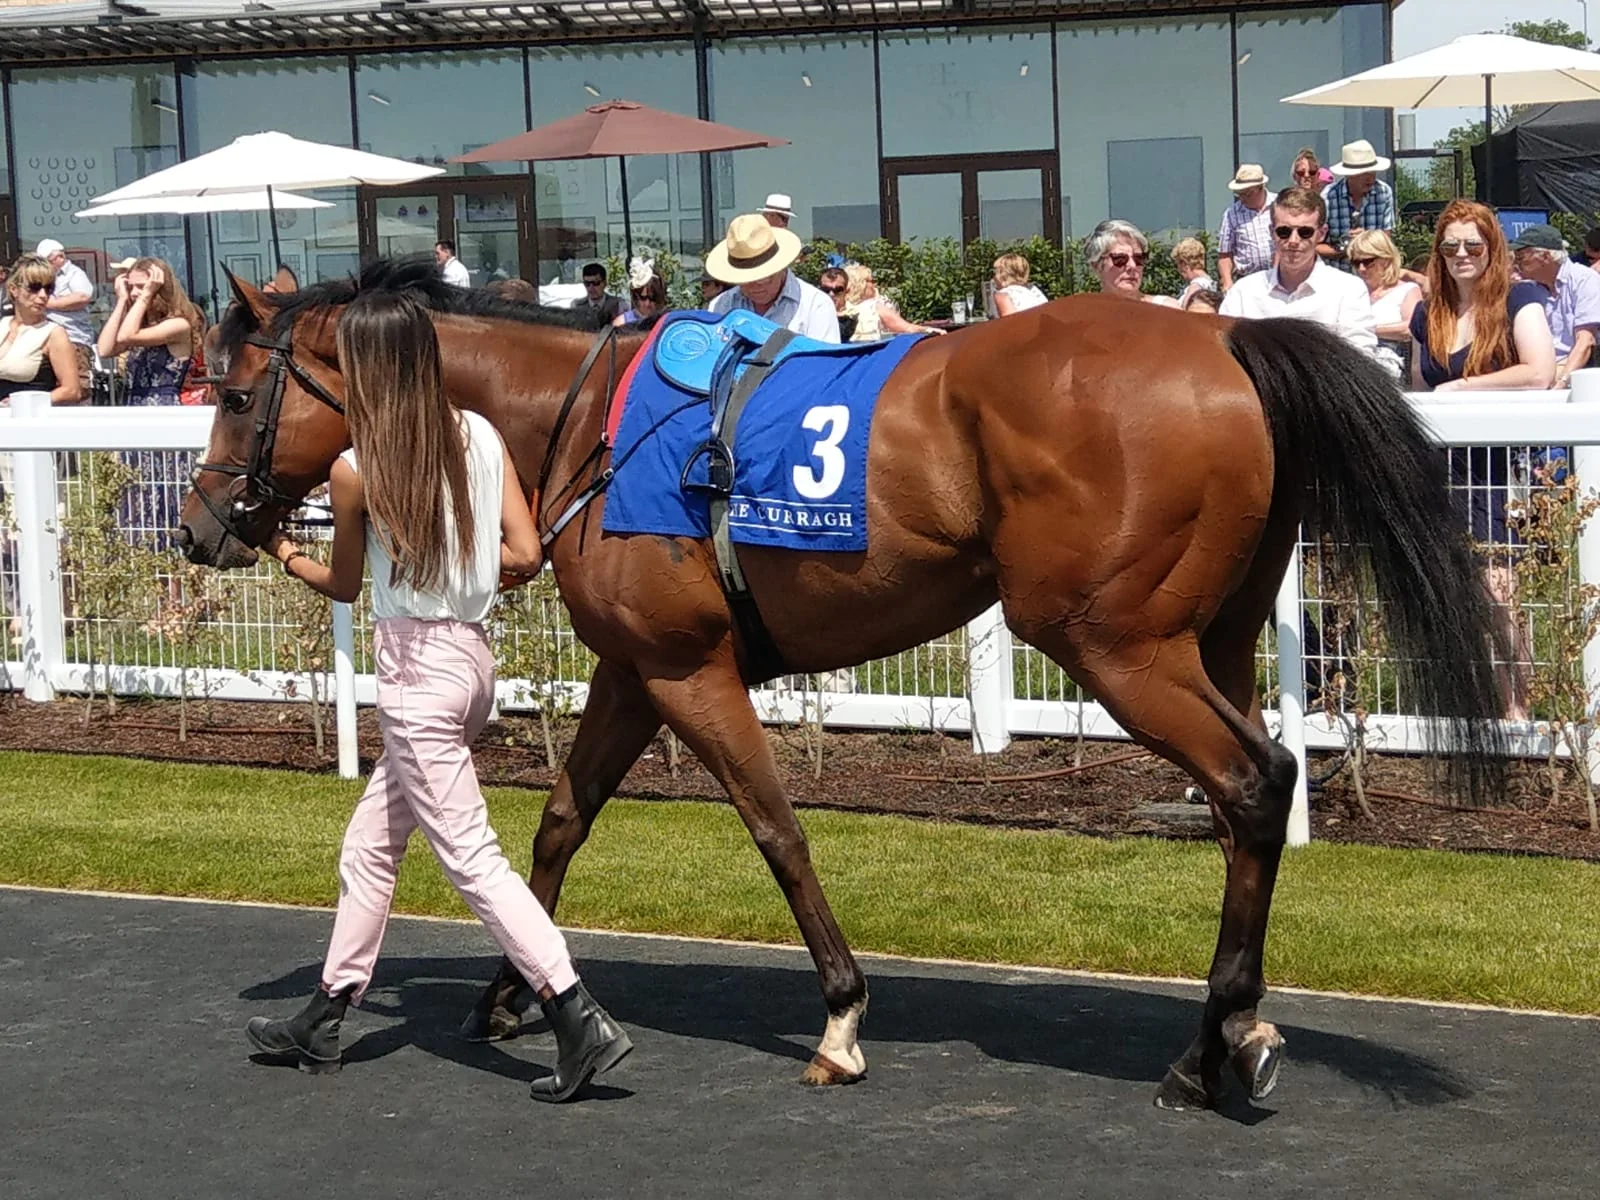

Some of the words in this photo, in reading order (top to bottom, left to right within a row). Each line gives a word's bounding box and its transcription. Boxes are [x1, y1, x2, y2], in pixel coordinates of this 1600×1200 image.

[1511, 221, 1536, 239] TH
[792, 404, 850, 499] 3
[757, 506, 853, 527] CURRAGH
